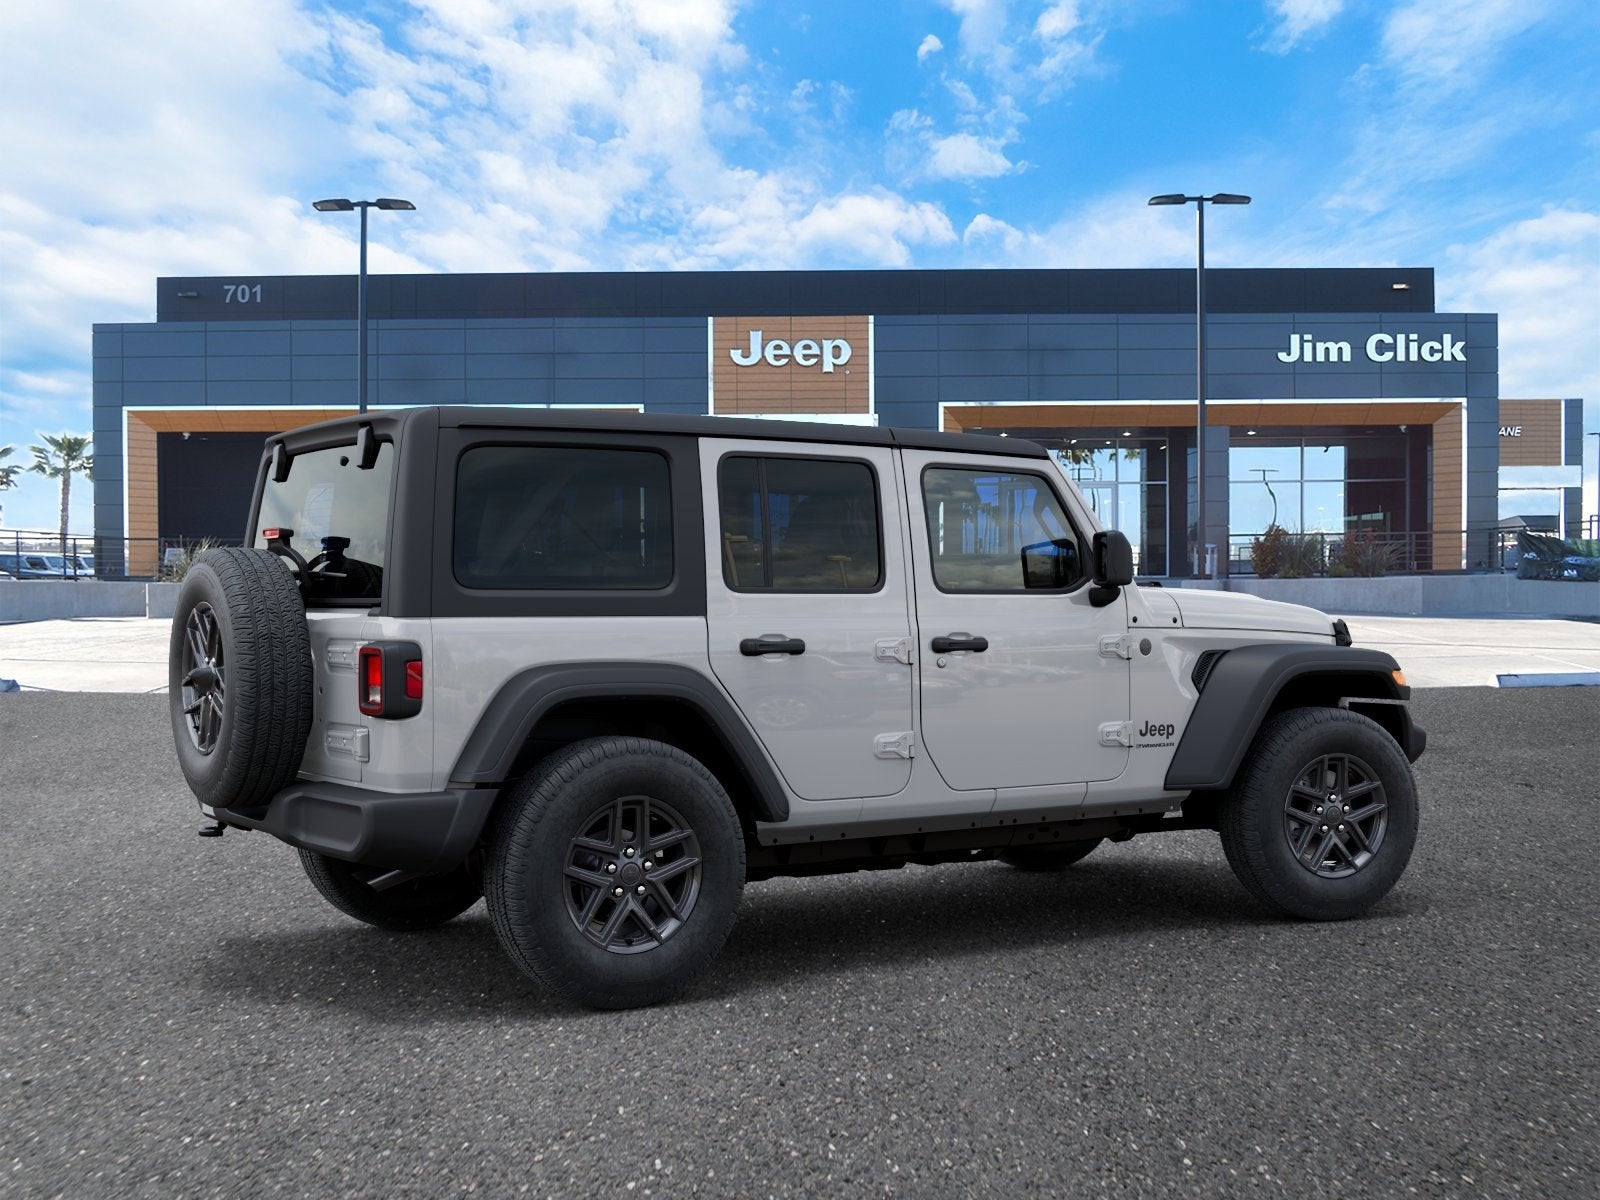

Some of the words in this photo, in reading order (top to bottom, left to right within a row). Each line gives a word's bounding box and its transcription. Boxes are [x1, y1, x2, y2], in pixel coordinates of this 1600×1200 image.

[223, 284, 262, 303] 701
[730, 330, 852, 373] Jeep
[1277, 333, 1351, 363] Jim
[1365, 333, 1467, 363] Click
[1139, 720, 1175, 739] Jeep
